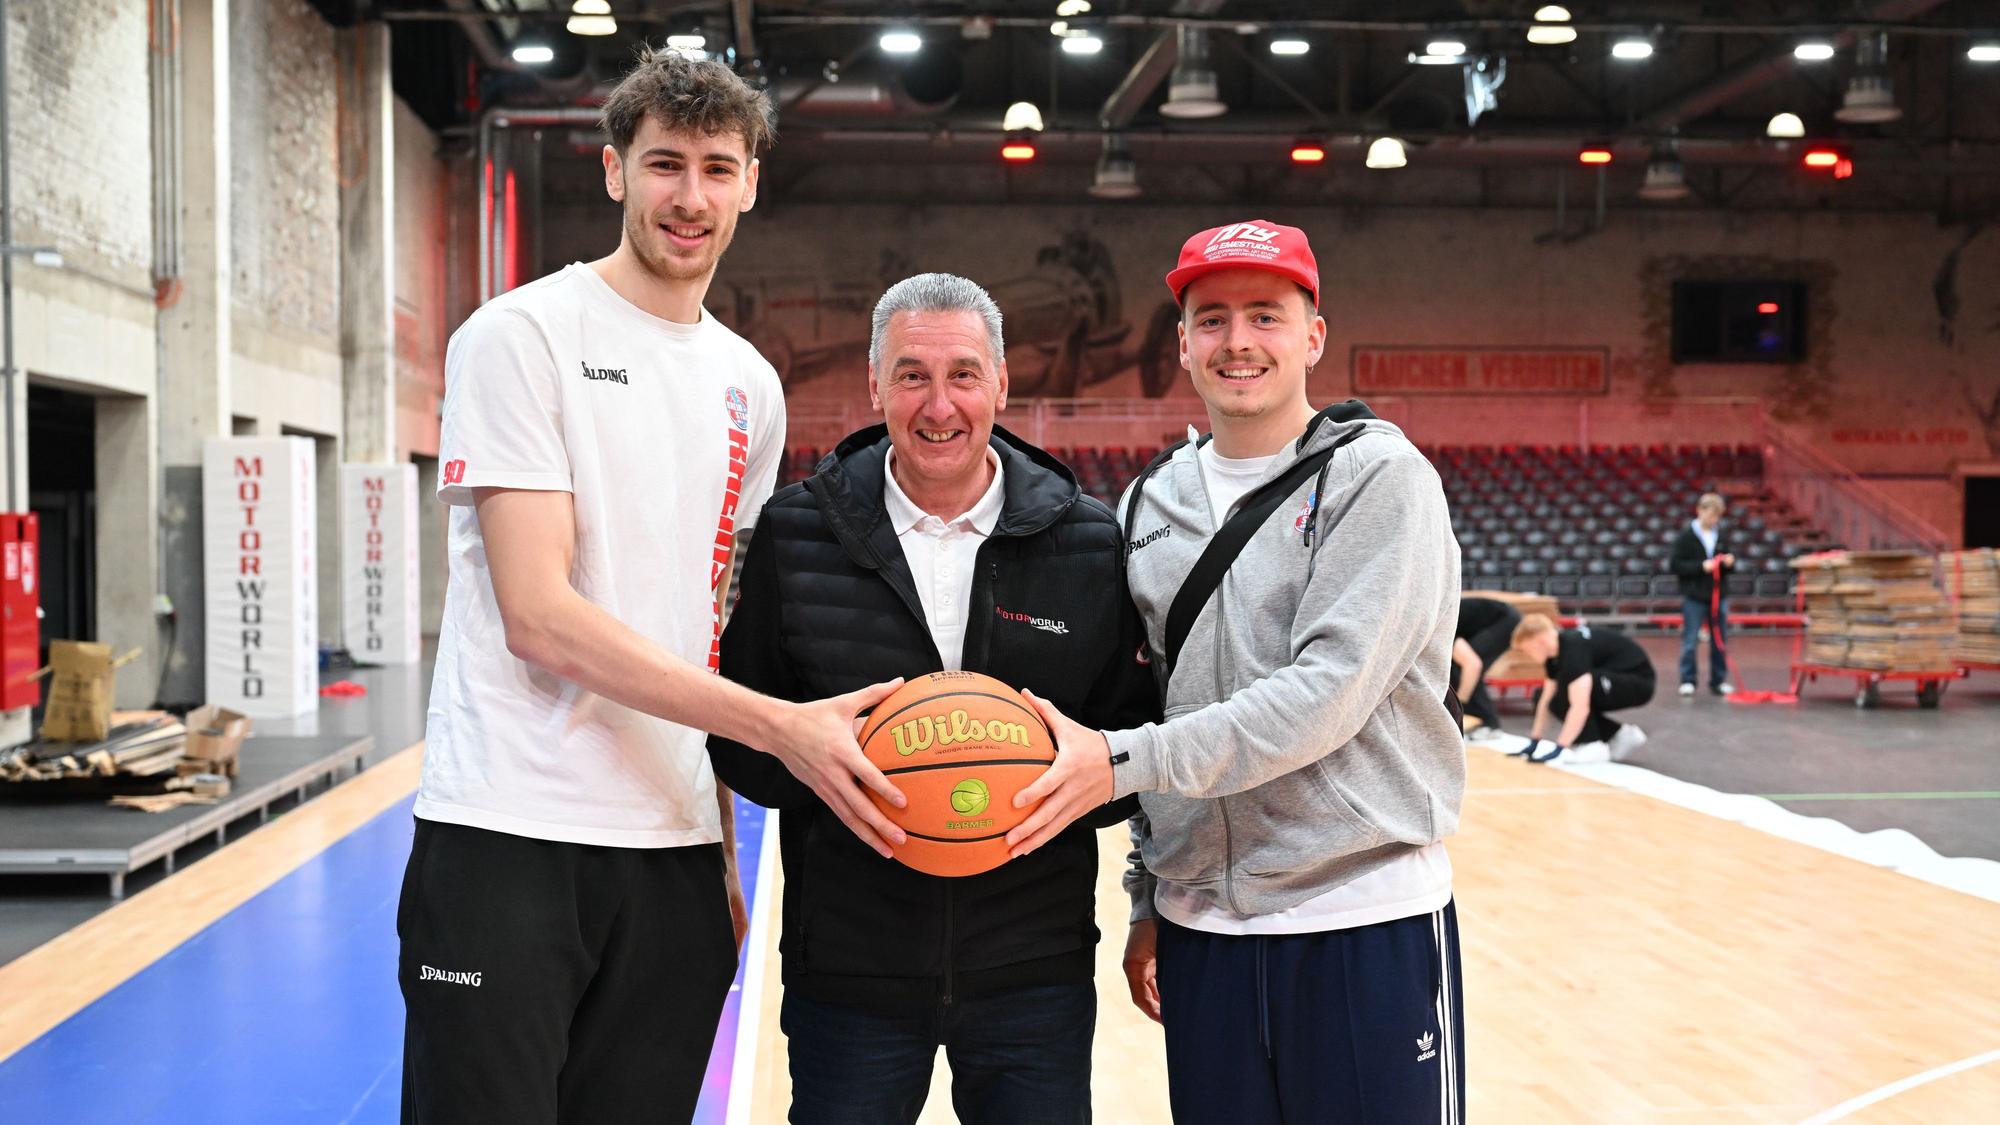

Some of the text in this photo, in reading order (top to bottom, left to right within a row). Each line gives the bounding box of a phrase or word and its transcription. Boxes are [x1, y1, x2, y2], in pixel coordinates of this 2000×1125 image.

[1128, 524, 1171, 554] PALDING
[234, 456, 267, 699] MOTORWORLD
[362, 476, 386, 652] MOTORWORLD
[890, 709, 1033, 757] Wilson
[945, 819, 993, 830] BARMER
[419, 964, 482, 987] SPALDING
[1417, 1049, 1436, 1062] adidas
